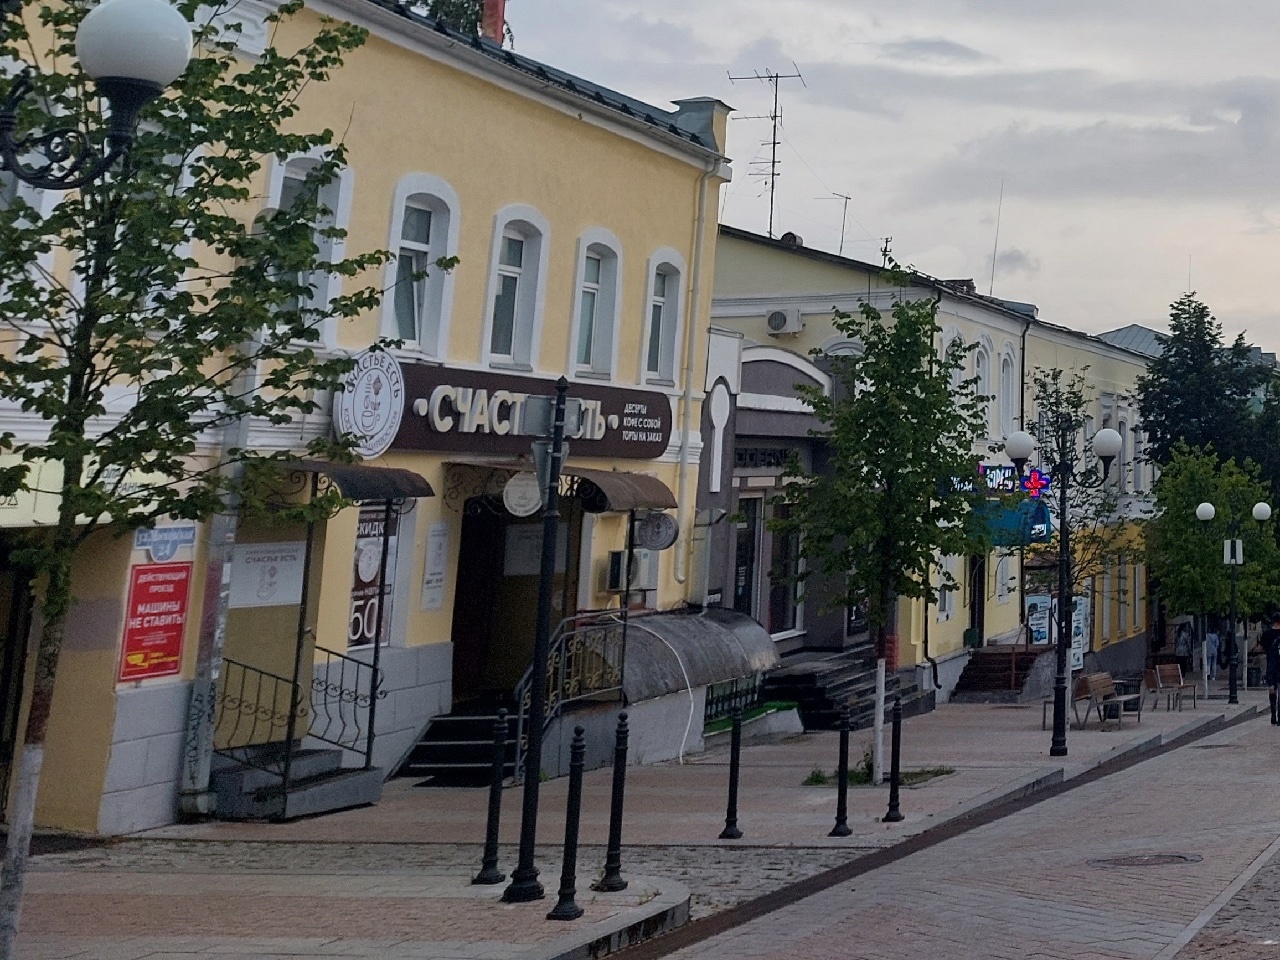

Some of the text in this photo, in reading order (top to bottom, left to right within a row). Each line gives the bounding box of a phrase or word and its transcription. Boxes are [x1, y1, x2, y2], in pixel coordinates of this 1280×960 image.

[386, 362, 401, 399] ЕСТЬ
[428, 384, 544, 437] СЧАСТ
[136, 600, 181, 616] МАШИНЫ
[128, 616, 143, 629] НЕ
